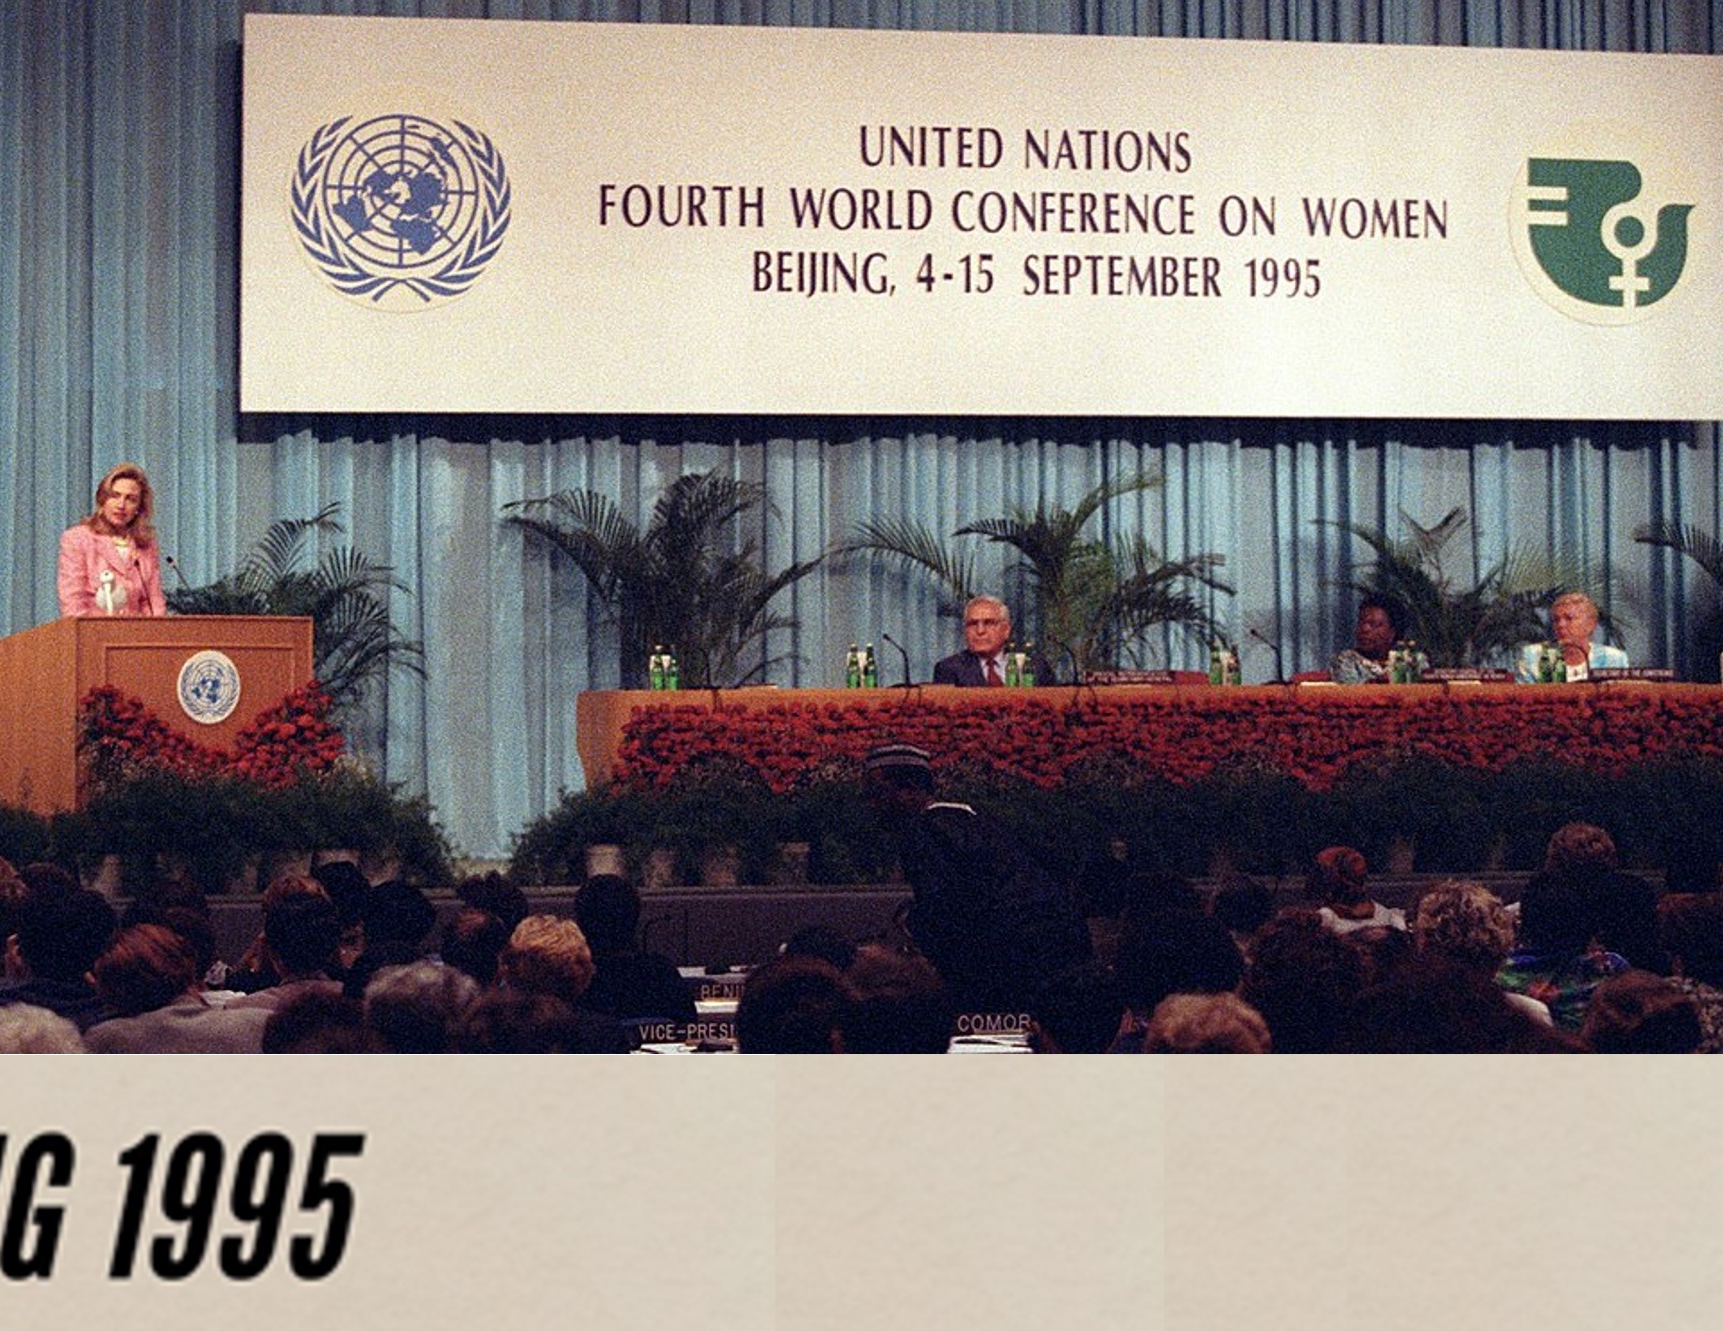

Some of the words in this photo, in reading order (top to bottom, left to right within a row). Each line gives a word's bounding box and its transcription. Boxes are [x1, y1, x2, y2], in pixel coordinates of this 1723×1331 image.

[860, 125, 1003, 169] UNITED
[1025, 129, 1191, 174] NATIONS
[599, 184, 764, 228] FOURTH
[790, 187, 933, 231] WORLD
[951, 190, 1194, 236] CONFERENCE
[1219, 195, 1275, 237] ON
[1303, 198, 1447, 239] WOMEN
[753, 250, 896, 298] BEIJING,
[1023, 254, 1222, 297] SEPTEMBER
[1245, 258, 1320, 297] 1995
[700, 983, 745, 1000] BENI
[638, 1022, 736, 1041] VICE-PRESI
[957, 1013, 1031, 1032] COMOR
